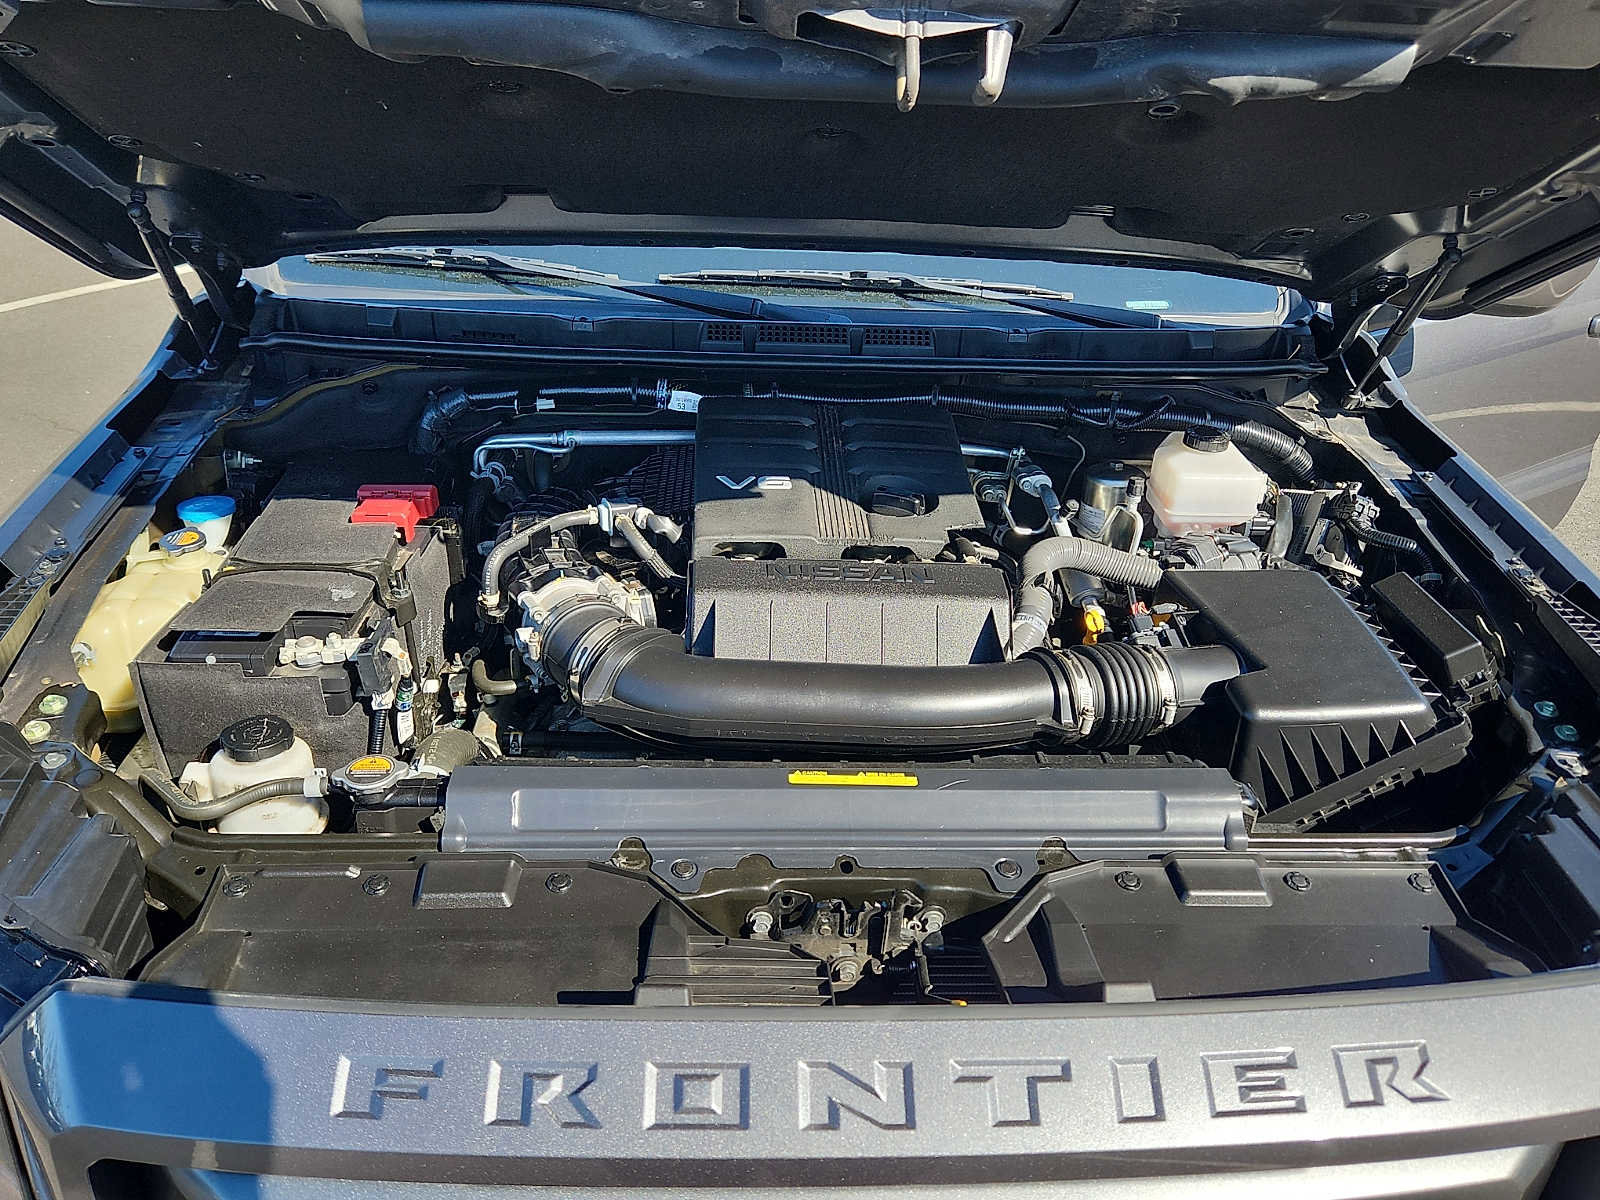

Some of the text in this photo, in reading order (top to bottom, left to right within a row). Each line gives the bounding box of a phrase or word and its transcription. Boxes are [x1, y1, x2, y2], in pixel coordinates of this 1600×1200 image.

[715, 475, 793, 490] V6
[765, 563, 936, 584] NISSAN
[329, 1039, 1451, 1131] FRONTIER
